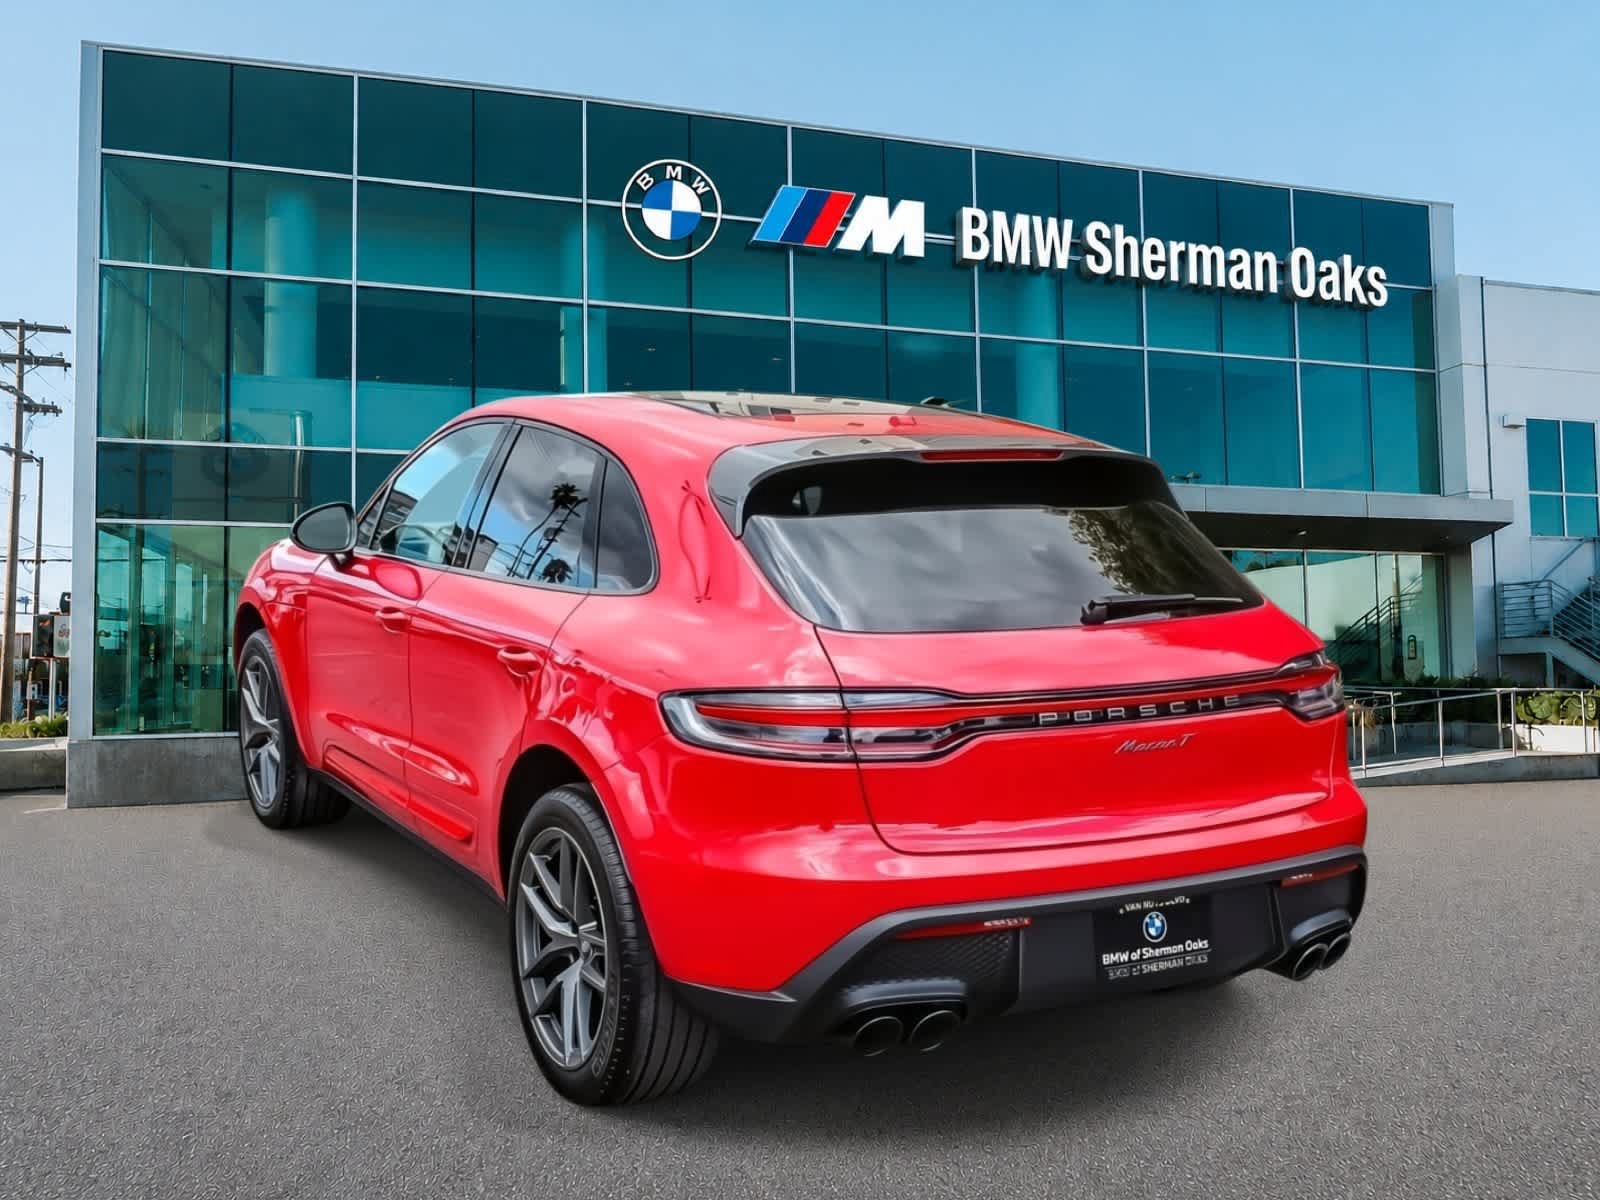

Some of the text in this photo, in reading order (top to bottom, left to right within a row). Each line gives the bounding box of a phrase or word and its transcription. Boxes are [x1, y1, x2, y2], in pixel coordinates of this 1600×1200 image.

[636, 165, 711, 195] BMW
[834, 194, 926, 258] M
[959, 206, 1388, 309] BMW Sherman Oaks
[1038, 694, 1241, 725] PORSCHE
[1102, 938, 1209, 966] BMW of Sherman Oaks
